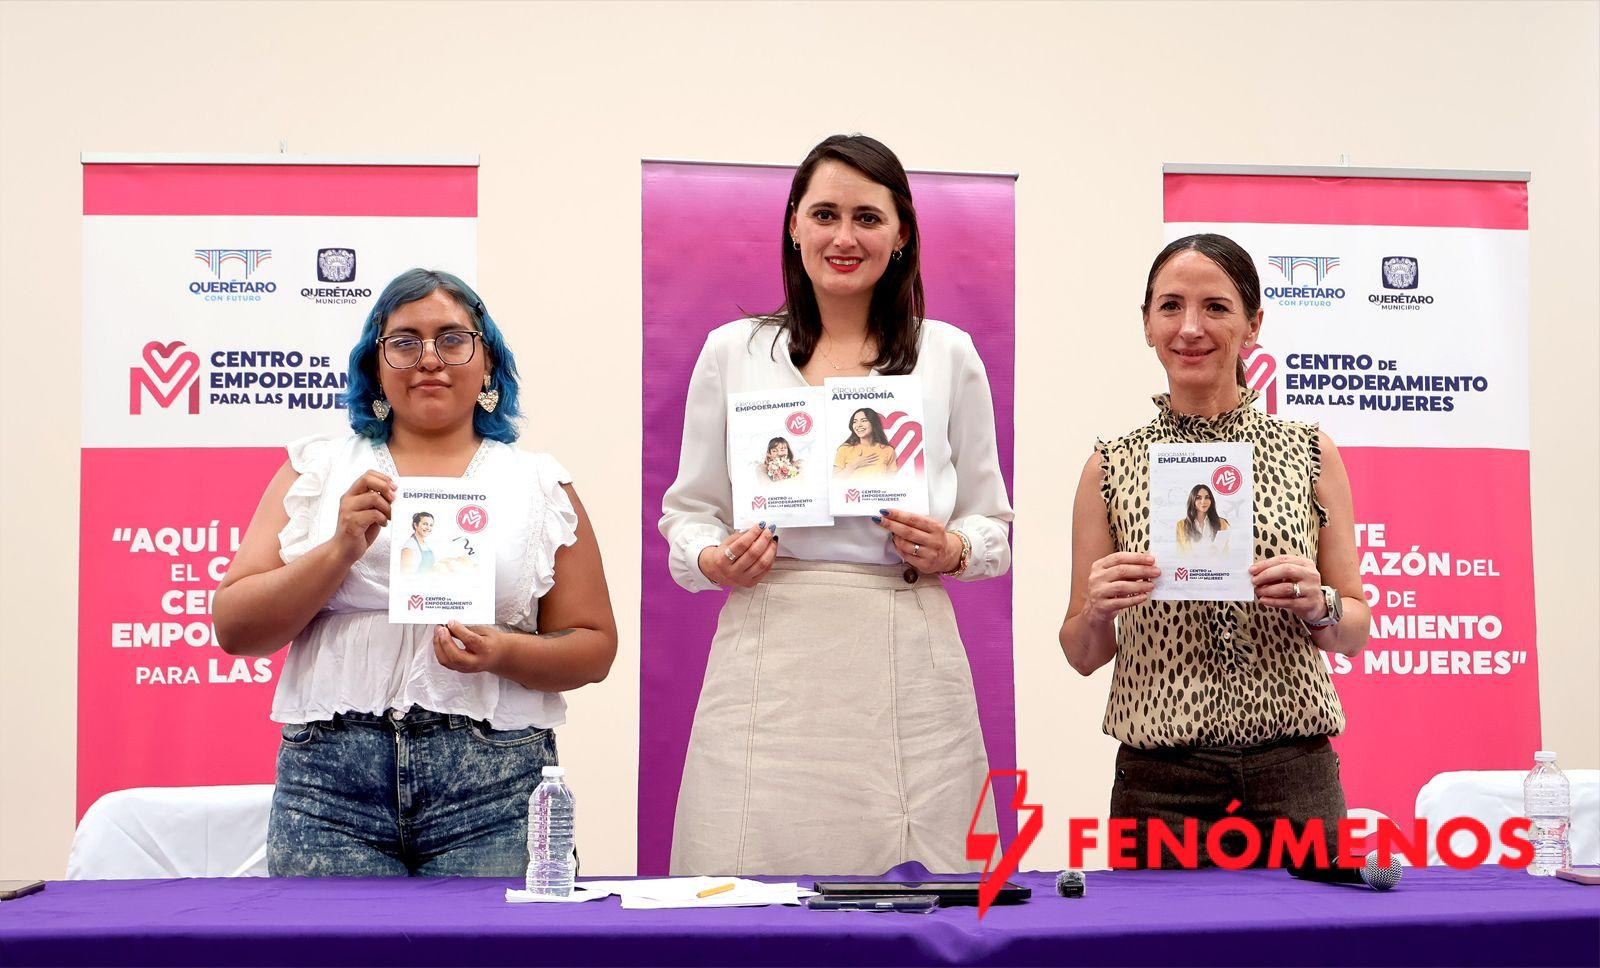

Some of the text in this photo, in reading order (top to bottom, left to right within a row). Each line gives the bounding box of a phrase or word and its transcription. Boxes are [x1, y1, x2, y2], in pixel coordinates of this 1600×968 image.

[189, 279, 276, 294] QUERÉTARO
[301, 286, 372, 299] QUERÉTARO
[1264, 285, 1346, 299] QUERÉTARO
[1368, 293, 1434, 305] QUERÉTARO
[210, 351, 330, 368] CENTRO DE
[1286, 353, 1397, 371] CENTRO DE
[1286, 374, 1488, 392] EMPODERAMIENTO
[210, 393, 251, 404] PARA
[255, 393, 283, 404] LAS
[832, 389, 895, 401] AUTONOMÍA
[735, 400, 806, 412] EMPODERAMIENTO
[1286, 394, 1455, 412] PARA LAS MUJERES
[1158, 456, 1227, 464] EMPLEABILIDAD
[403, 492, 487, 501] EMPRENDIMIENTO
[171, 564, 200, 582] EL
[1456, 559, 1500, 576] DEL
[1387, 591, 1417, 608] DE
[136, 658, 273, 685] PARA LAS
